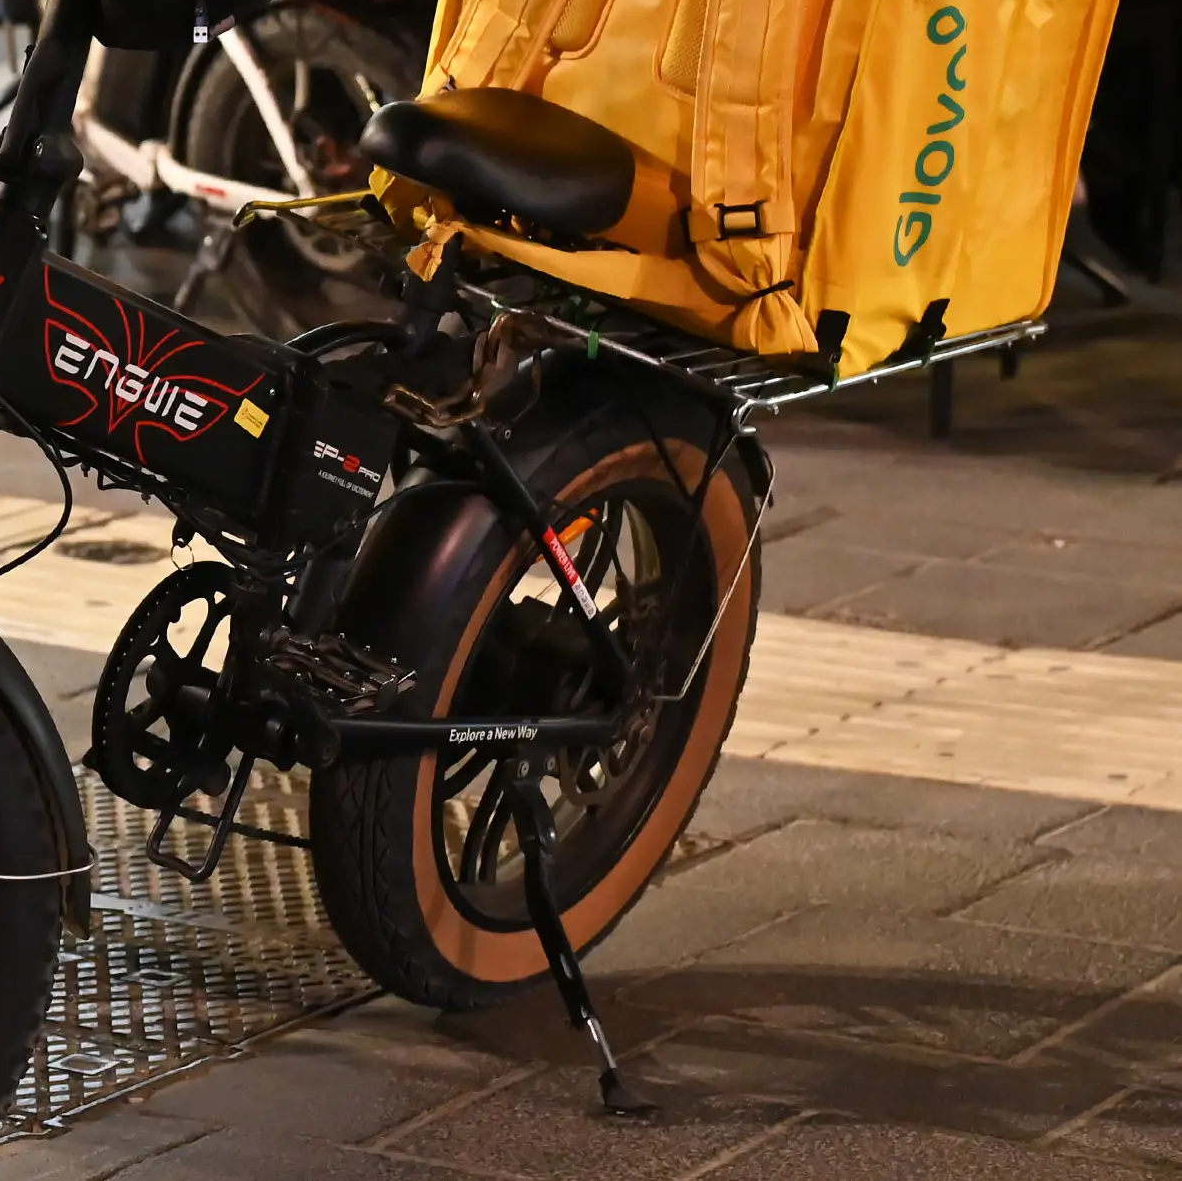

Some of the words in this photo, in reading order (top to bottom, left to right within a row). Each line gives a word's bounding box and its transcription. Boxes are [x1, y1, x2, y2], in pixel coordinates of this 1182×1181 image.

[54, 332, 209, 431] ENGWE
[549, 536, 570, 566] POWER
[449, 727, 485, 744] Explore
[486, 730, 493, 741] a
[494, 726, 517, 740] New
[517, 725, 538, 740] Way
